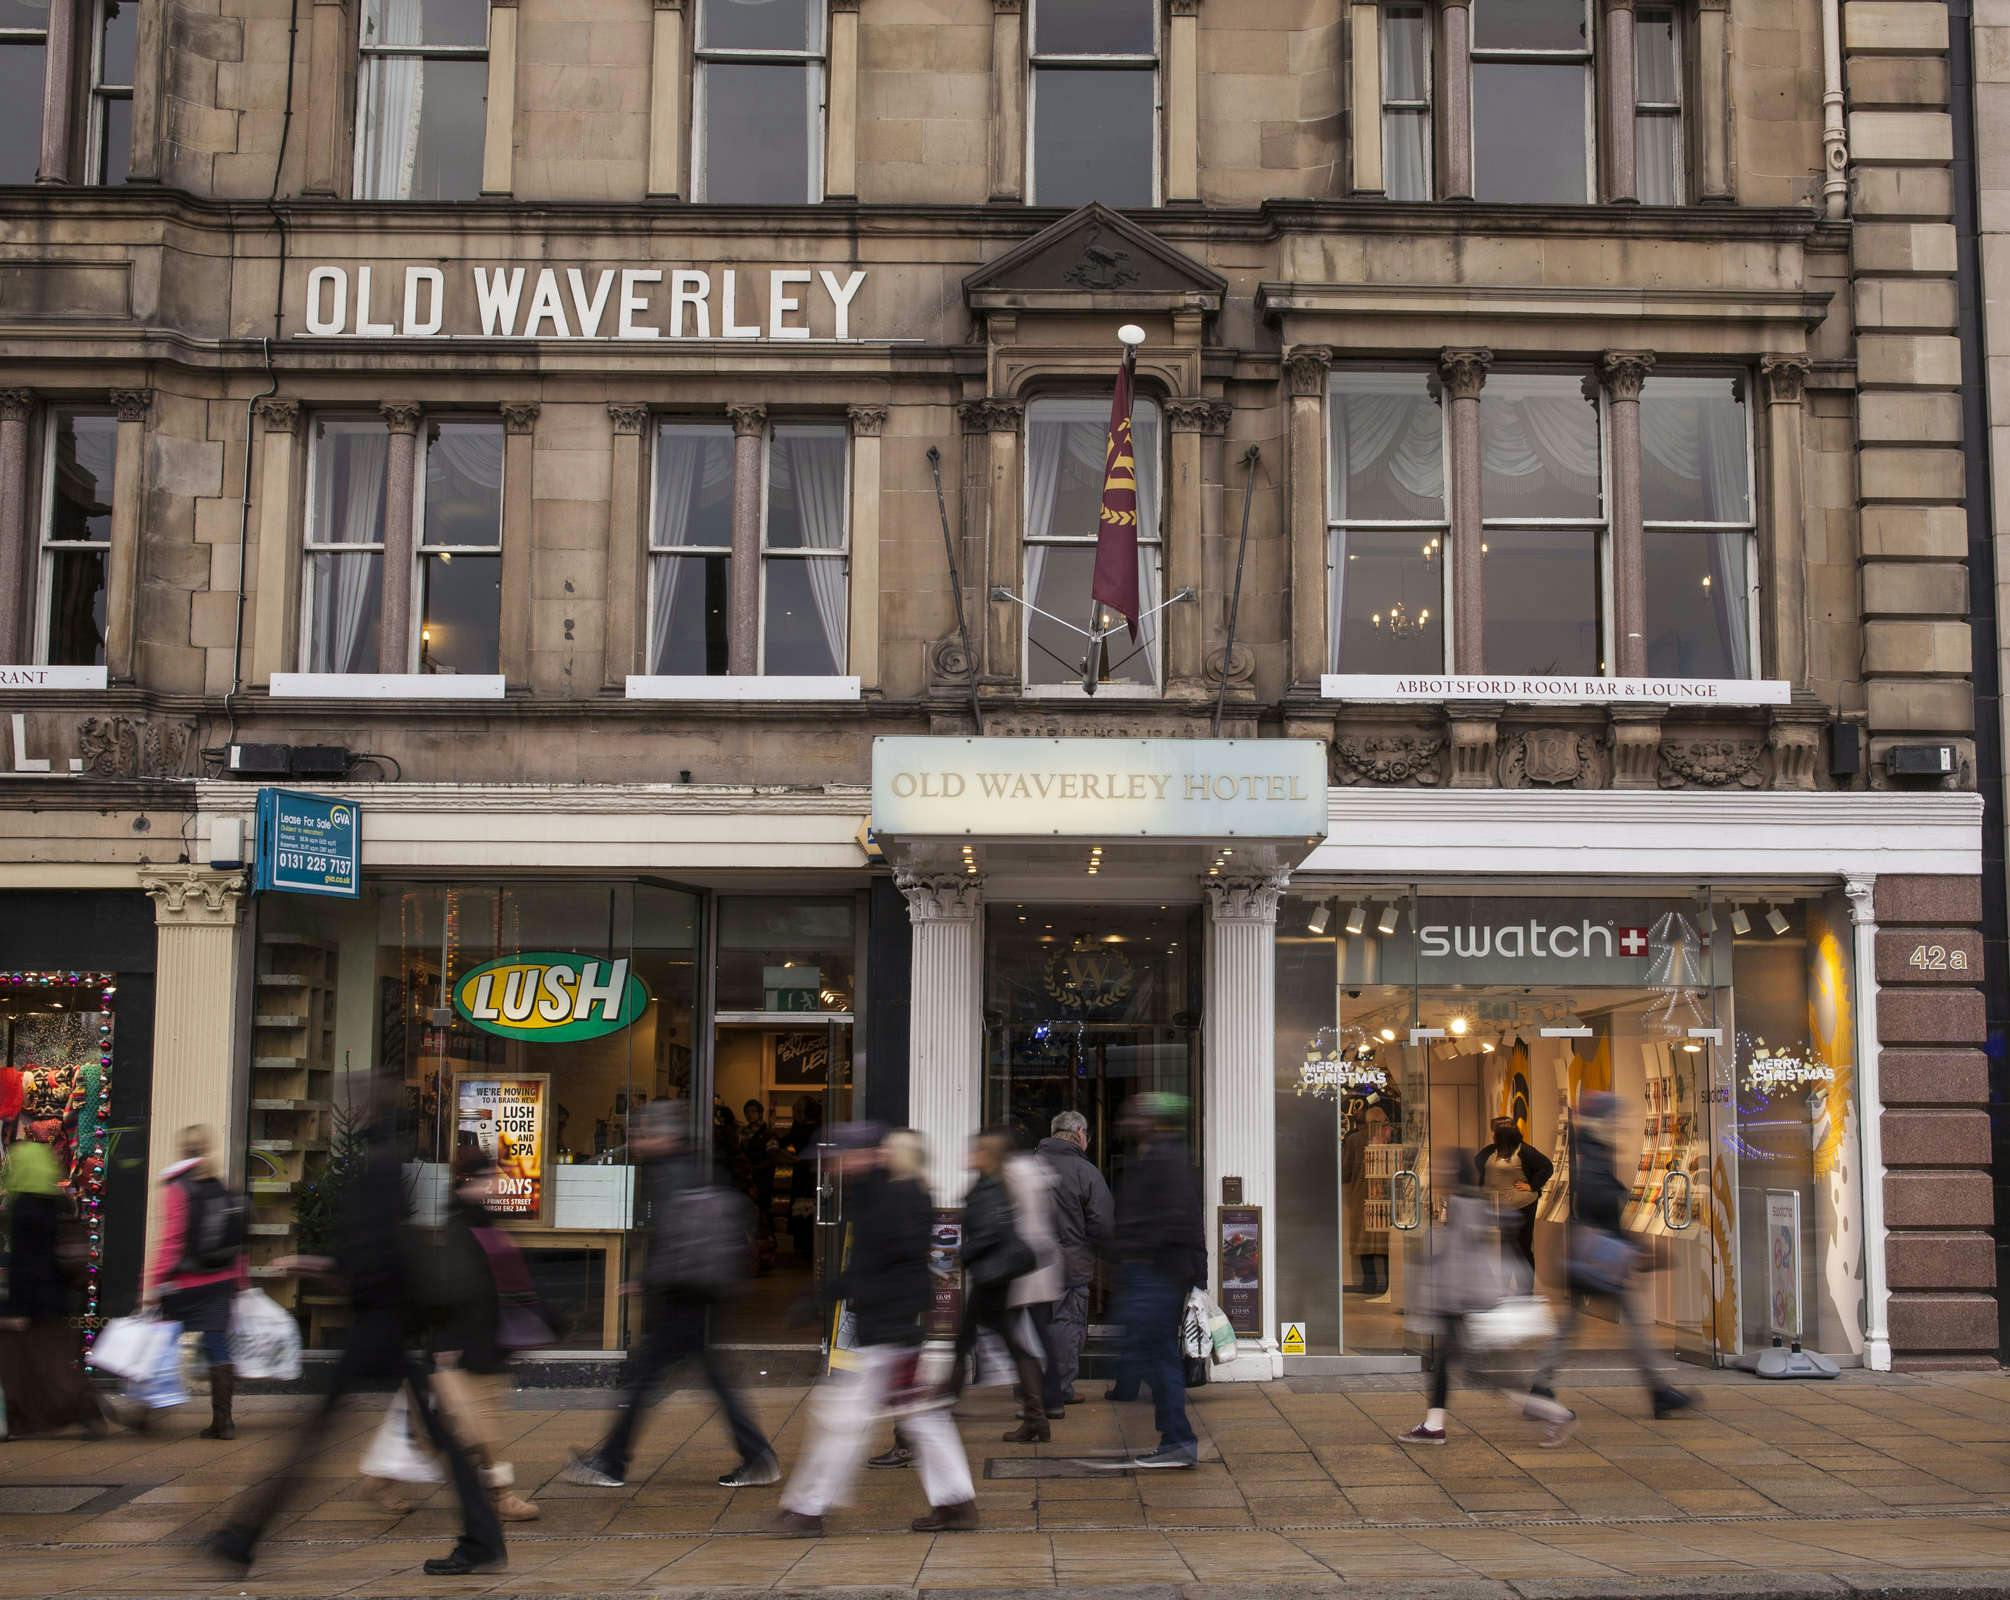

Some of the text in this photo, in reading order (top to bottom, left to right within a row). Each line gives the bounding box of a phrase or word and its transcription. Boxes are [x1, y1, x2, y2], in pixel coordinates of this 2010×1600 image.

[305, 265, 867, 339] OLD WAVERLEY
[1396, 680, 1719, 697] ABBOTSFORD ROOM BAR & LOUNGE
[891, 771, 1310, 801] OLD WAVERLEY HOTEL
[280, 812, 332, 830] Lease For Sale
[333, 812, 350, 826] GVA
[280, 853, 352, 875] 0131 225 7137
[1420, 919, 1612, 958] swatch
[1909, 945, 1968, 970] 42a
[471, 958, 629, 1022] LUSH
[1303, 1061, 1352, 1073] MERRY
[1752, 1058, 1800, 1070] MERRY
[1303, 1072, 1387, 1084] CHRISTMAS
[1753, 1068, 1836, 1081] CHRISTMAS
[476, 1087, 536, 1097] WE'RE MOVING
[503, 1106, 535, 1119] LUSH
[495, 1120, 535, 1133] STORE
[517, 1134, 535, 1142] AND
[511, 1143, 534, 1156] SPA
[498, 1178, 533, 1195] DAYS
